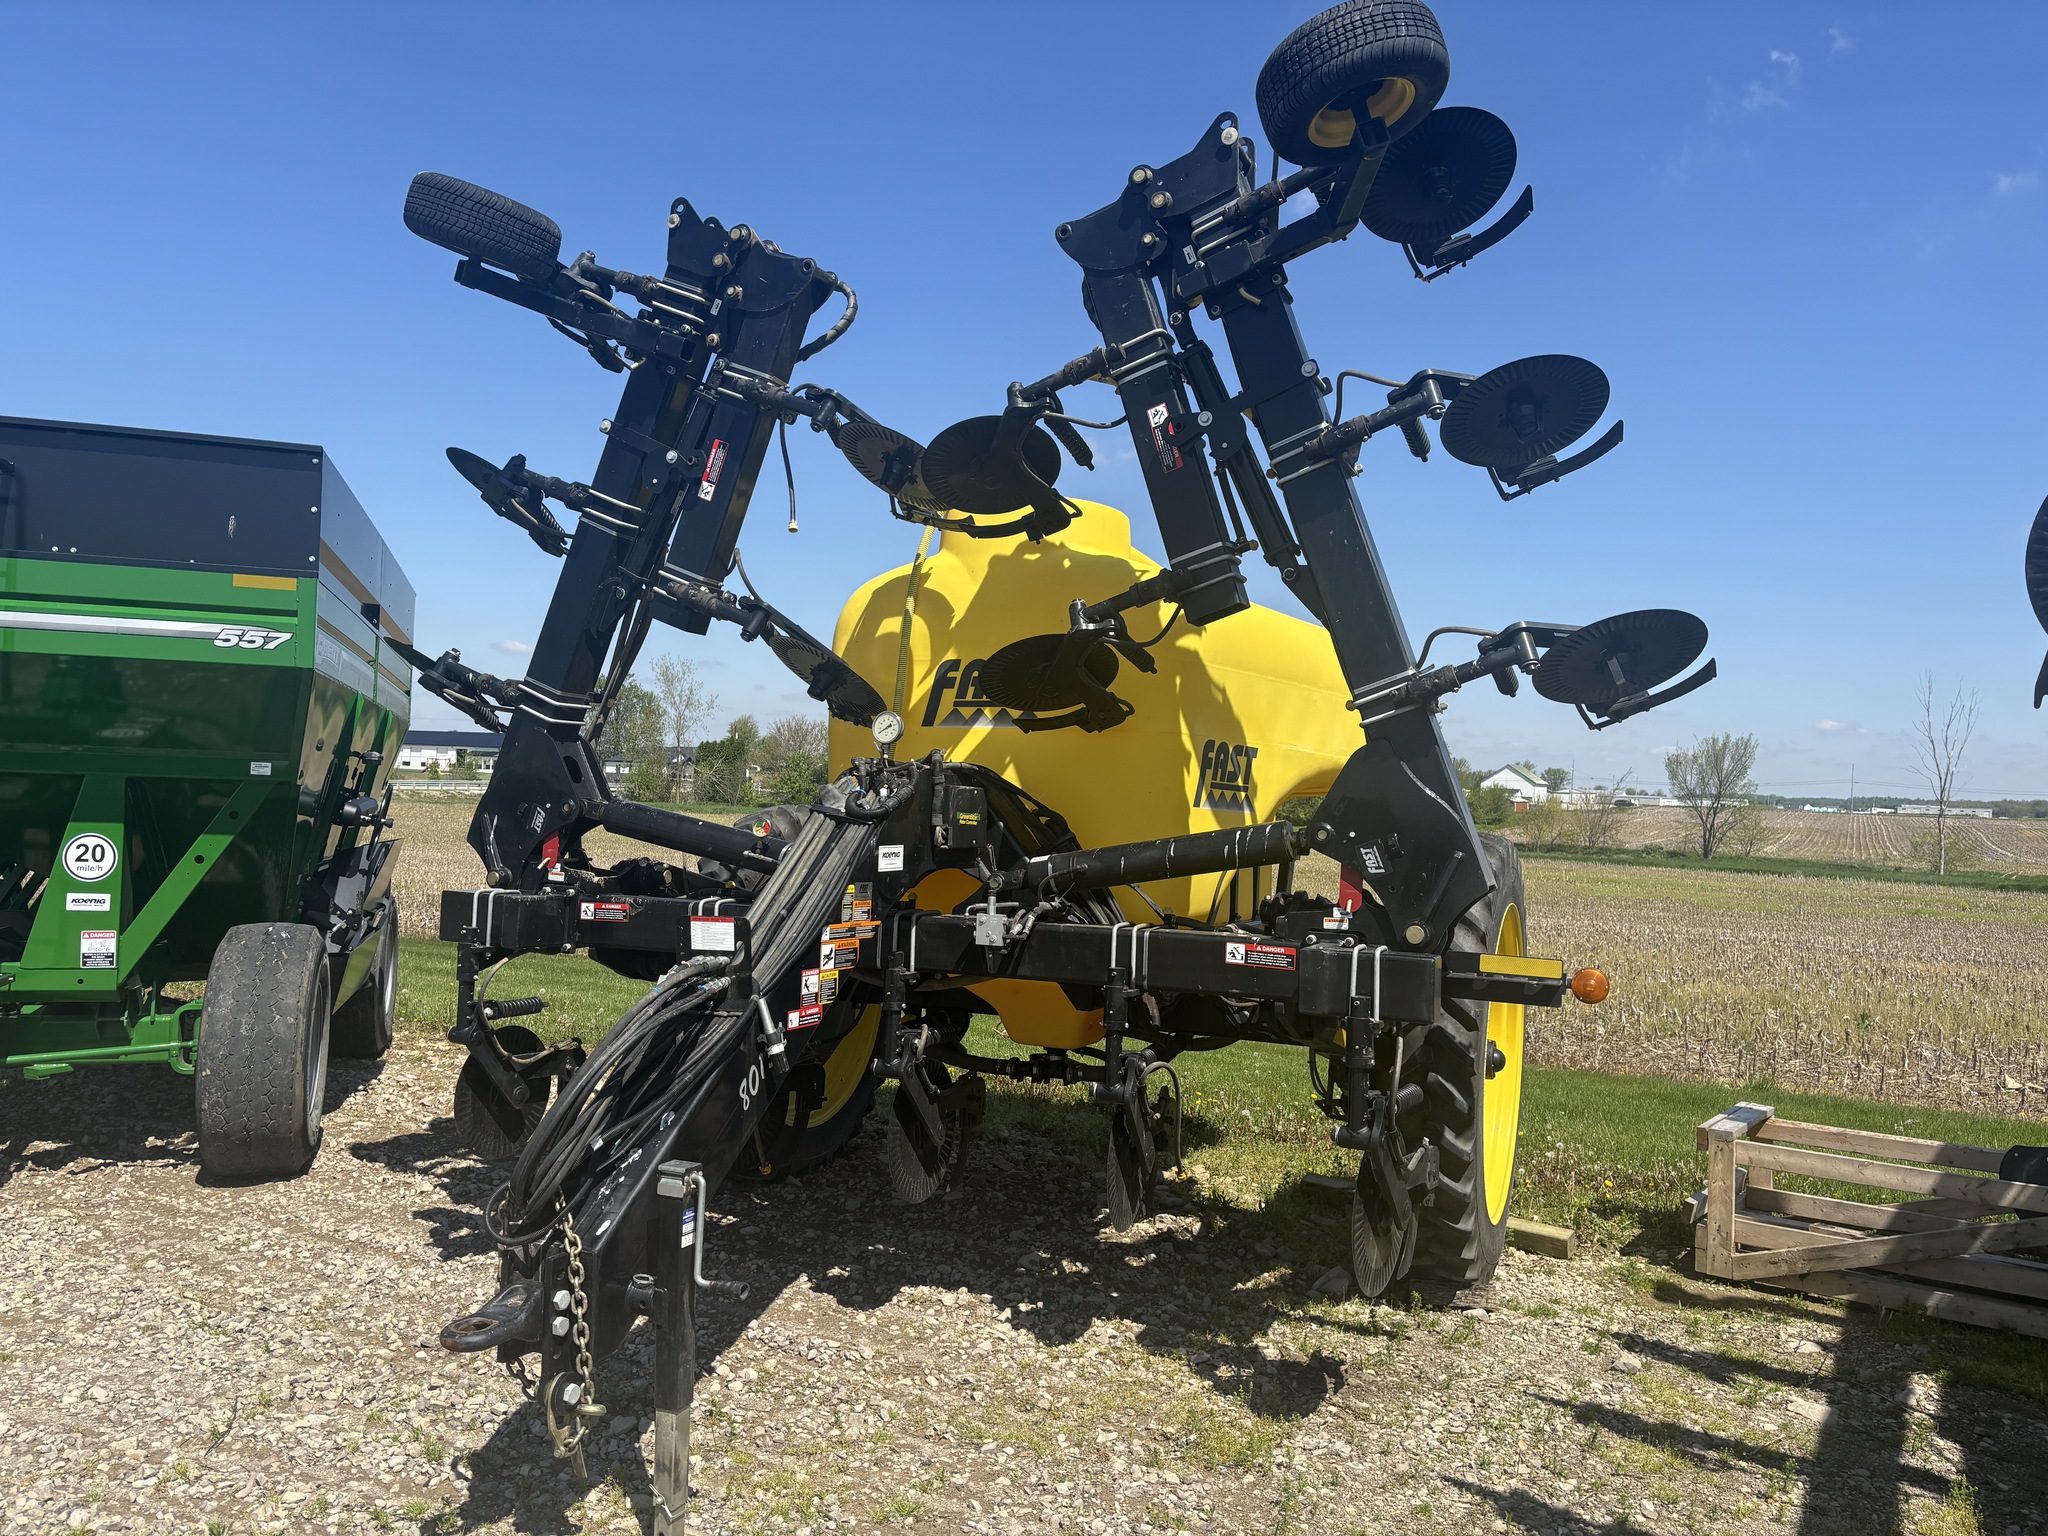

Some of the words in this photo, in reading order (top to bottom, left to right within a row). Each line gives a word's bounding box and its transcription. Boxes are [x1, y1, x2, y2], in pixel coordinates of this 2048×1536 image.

[213, 628, 294, 650] 557
[921, 659, 987, 727] FA
[1193, 739, 1258, 808] FAST
[534, 807, 545, 833] FAST
[75, 844, 105, 862] 20
[1360, 847, 1385, 873] FAST
